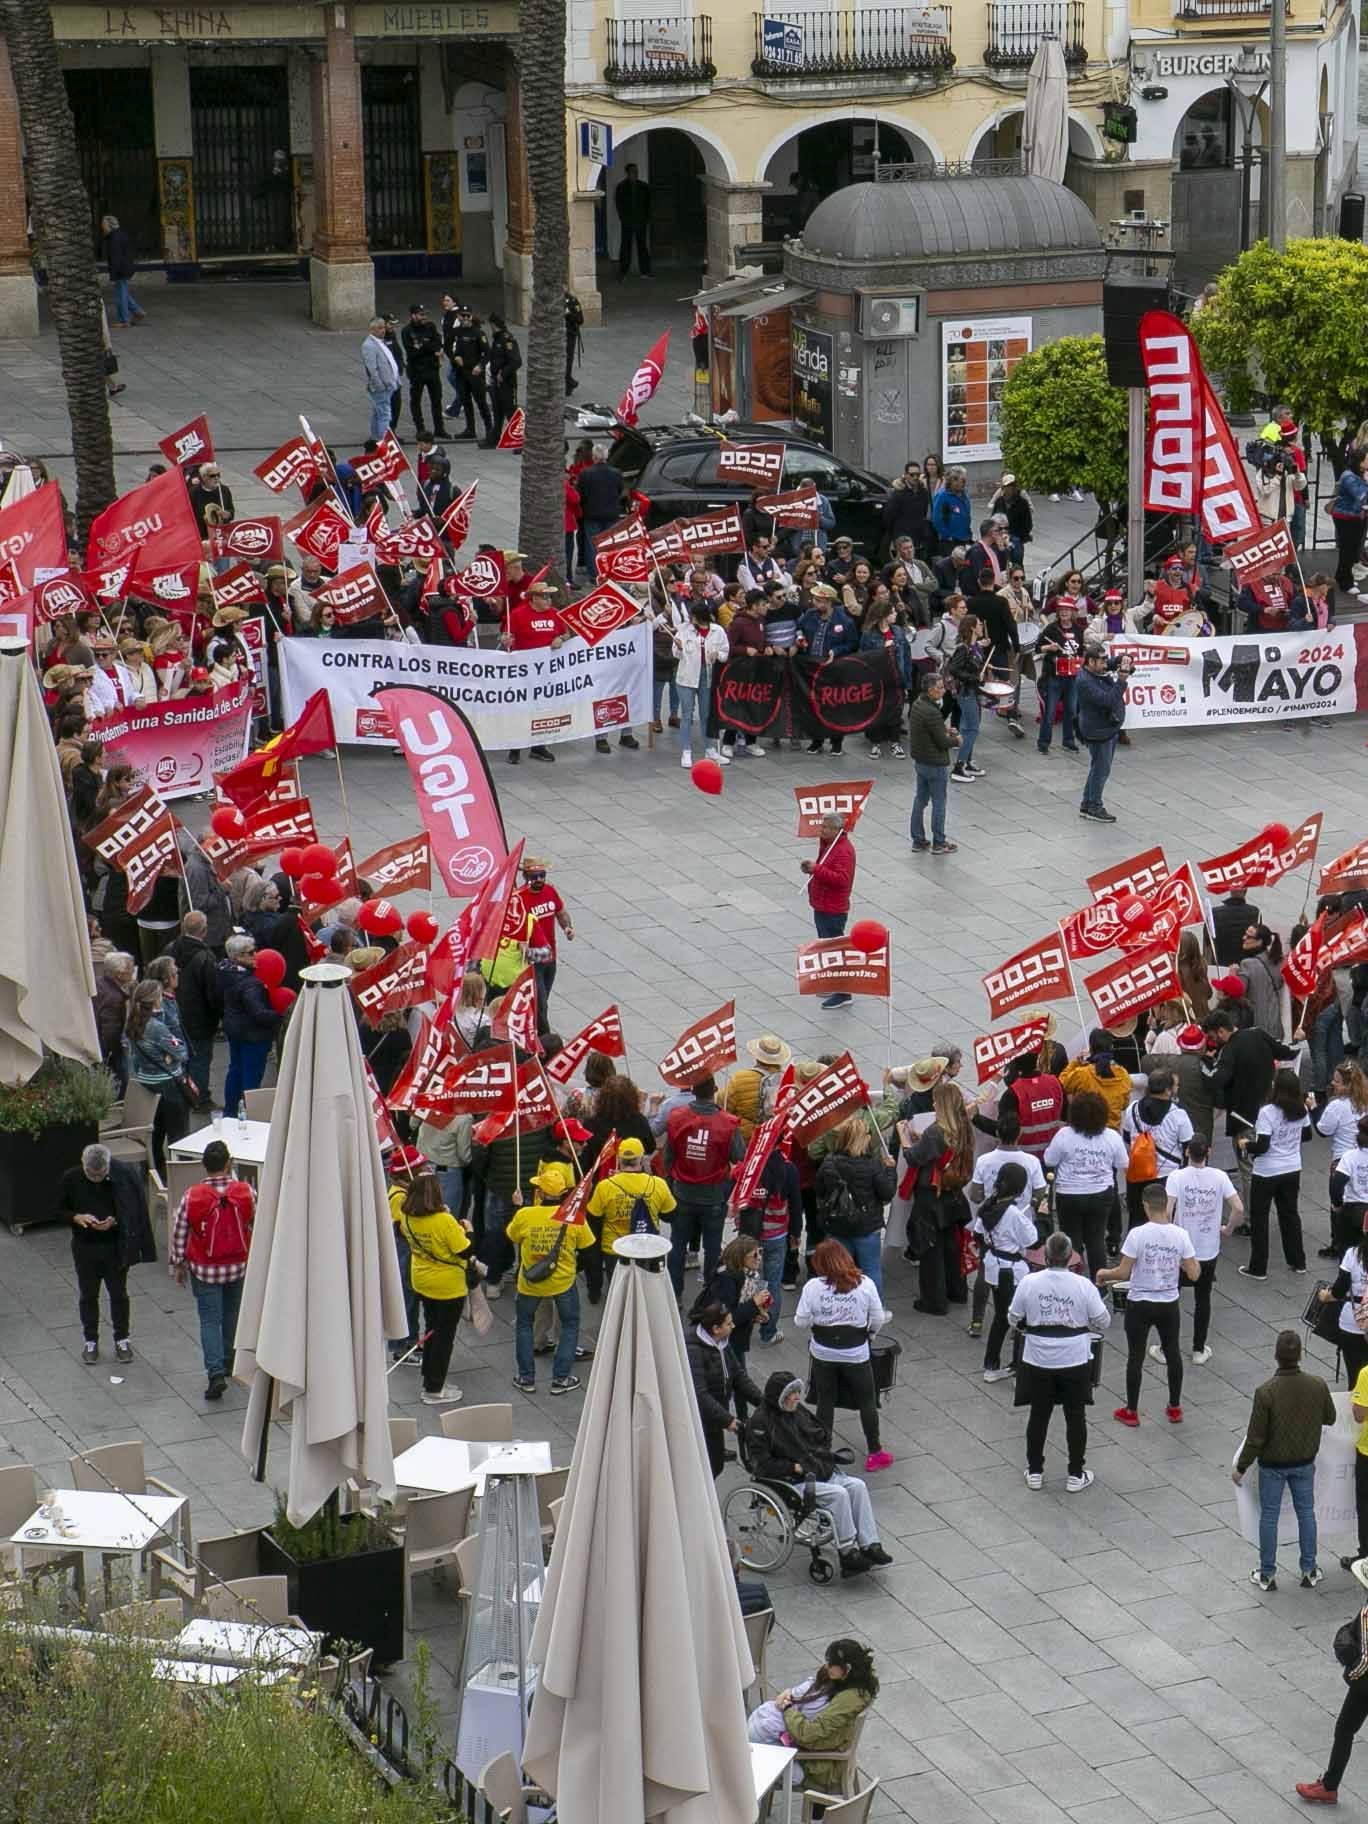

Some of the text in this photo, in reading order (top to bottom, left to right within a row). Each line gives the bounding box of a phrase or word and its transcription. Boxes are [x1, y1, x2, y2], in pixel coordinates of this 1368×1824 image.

[105, 9, 137, 36] LA
[384, 8, 489, 32] MUEBLES
[1160, 54, 1234, 77] BURGER
[582, 597, 610, 622] UGT
[322, 641, 636, 679] CONTRA LOS RECORTES Y EN DEFENSA
[1298, 644, 1345, 665] 2024
[533, 674, 594, 700] PÚBLICA
[820, 682, 874, 705] RUGE
[132, 716, 159, 731] una
[163, 705, 219, 726] Sanidad
[220, 700, 231, 714] de
[1142, 708, 1188, 717] Extremadura
[1206, 706, 1274, 717] #PLENOEMPLEO
[1083, 903, 1119, 929] UGT
[1031, 1098, 1054, 1109] CCOO
